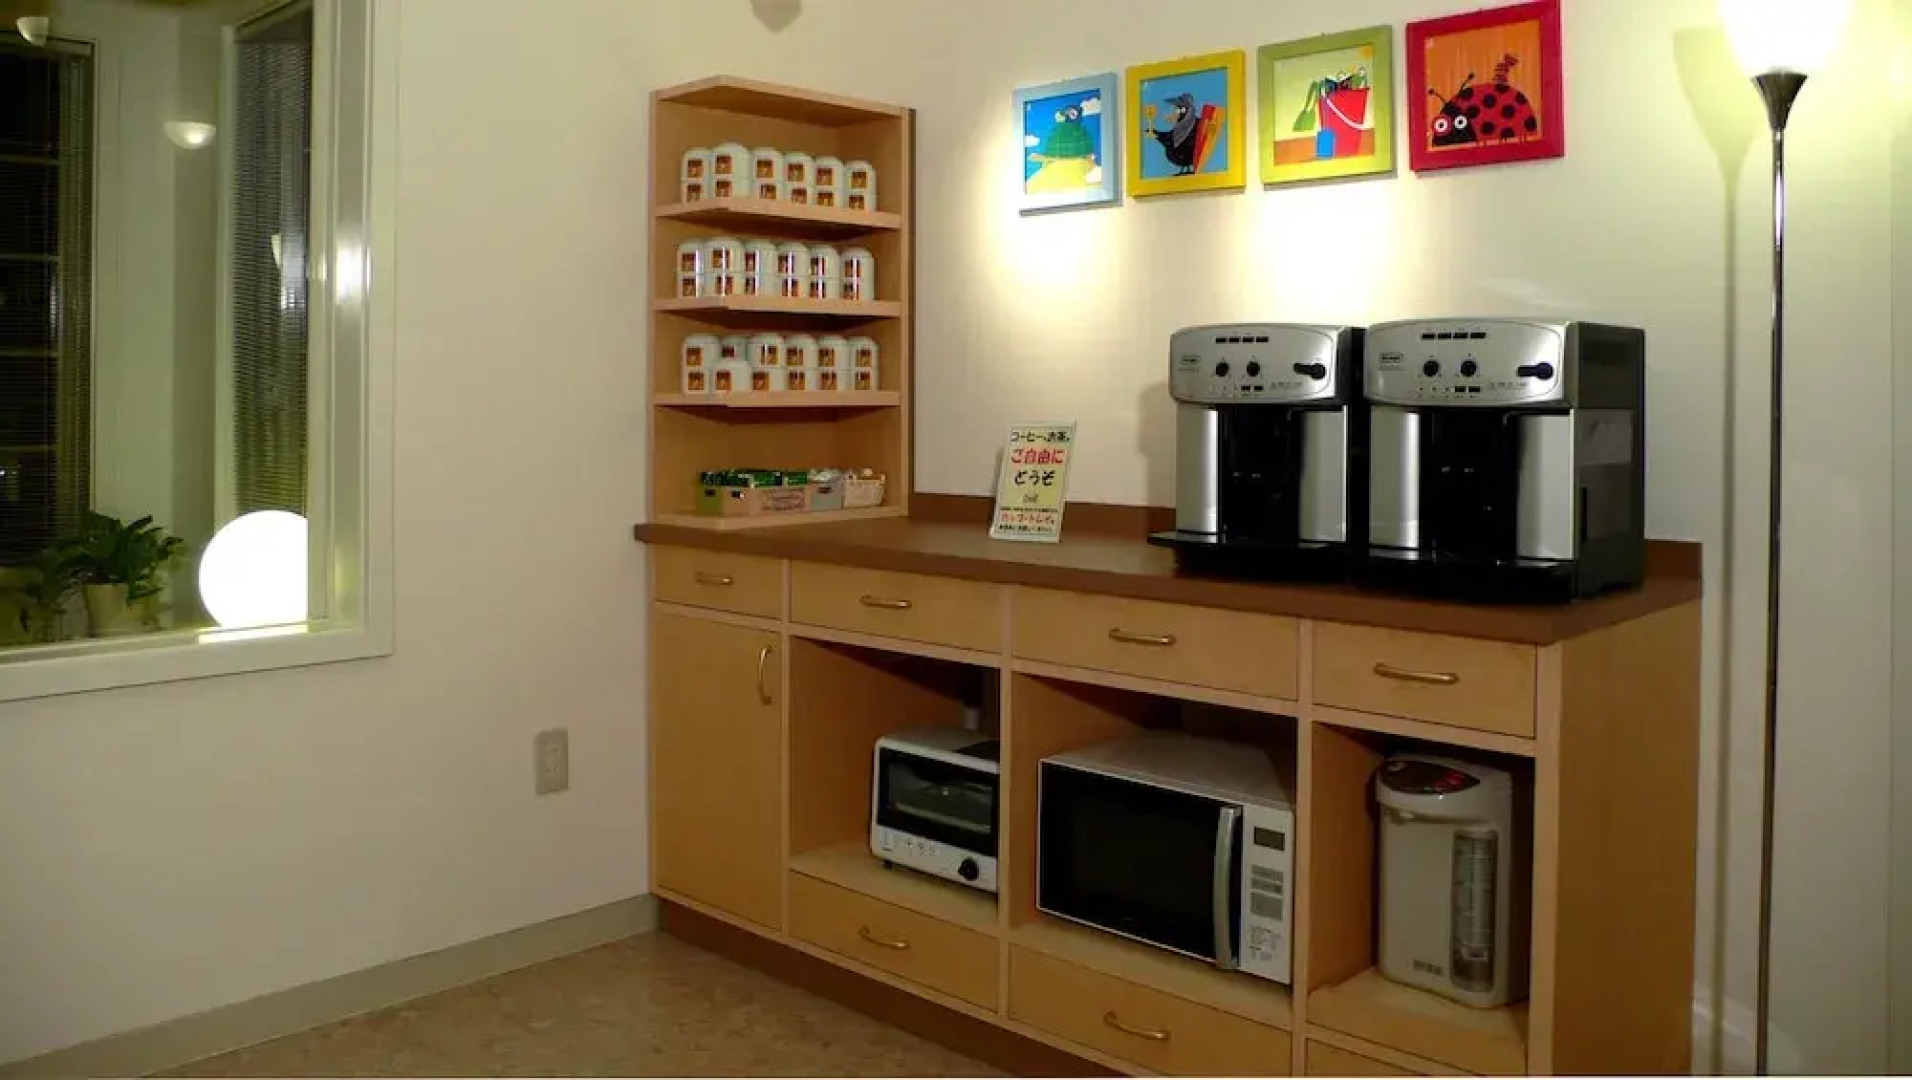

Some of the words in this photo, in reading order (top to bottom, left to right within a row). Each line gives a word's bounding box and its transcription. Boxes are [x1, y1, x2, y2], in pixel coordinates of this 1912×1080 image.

[1011, 447, 1064, 464] ご自由に
[1015, 469, 1056, 486] どうぞ
